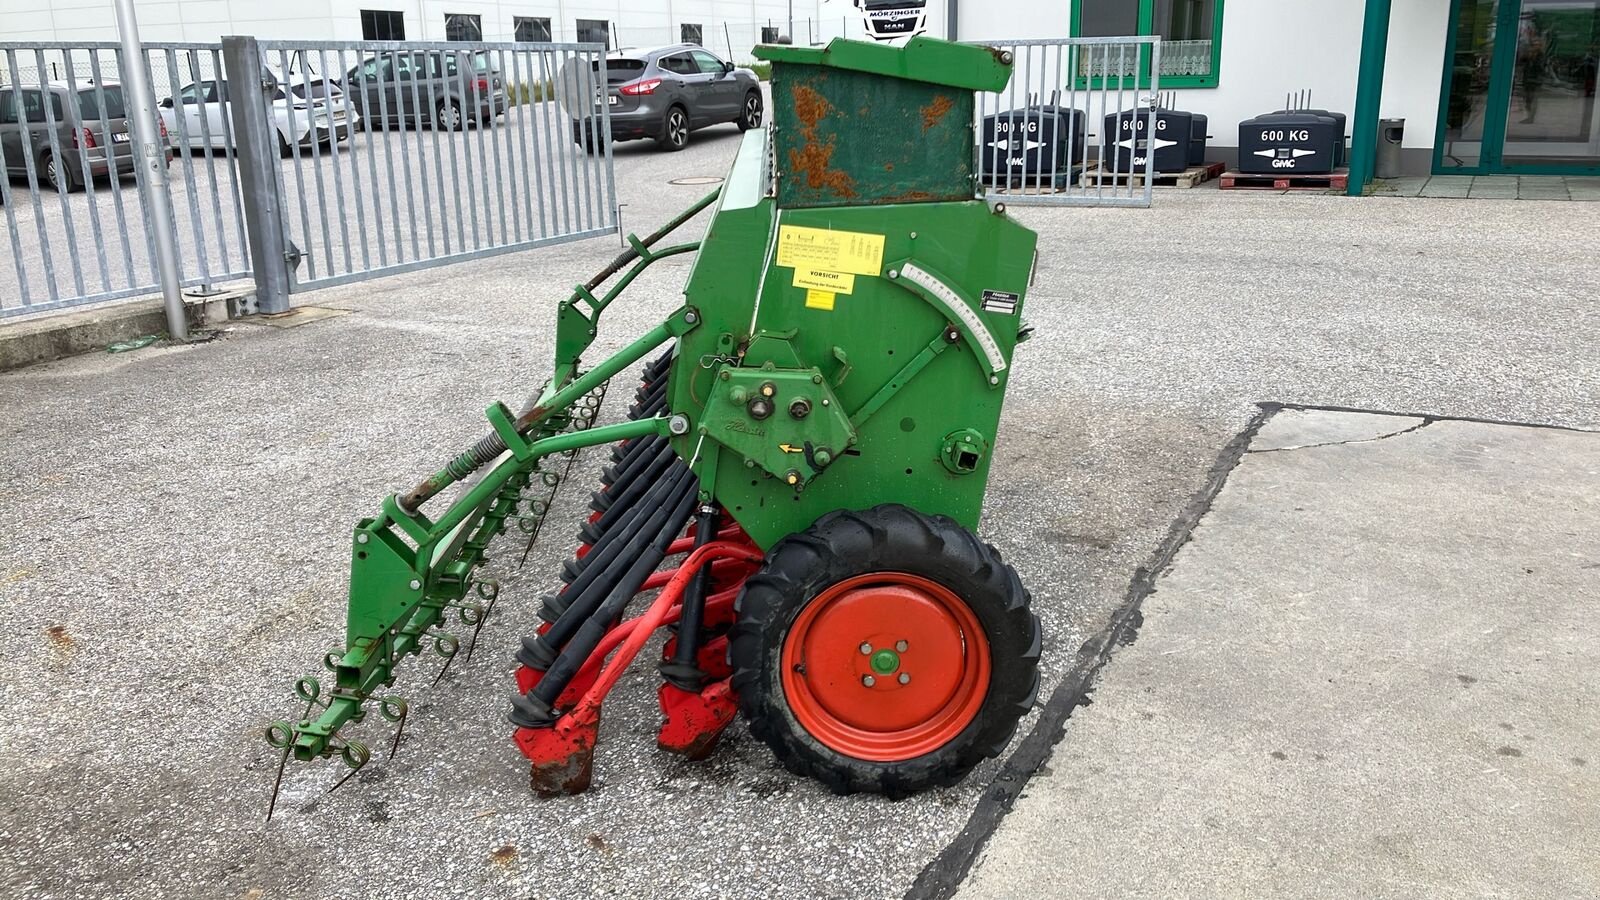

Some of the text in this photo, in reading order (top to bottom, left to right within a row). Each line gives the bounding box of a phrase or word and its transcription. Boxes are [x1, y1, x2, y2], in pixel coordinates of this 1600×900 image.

[1152, 120, 1167, 130] G
[1261, 130, 1309, 141] 600 KG
[1133, 156, 1148, 165] GM
[1272, 159, 1295, 168] GMC
[810, 271, 839, 279] VORSICHT
